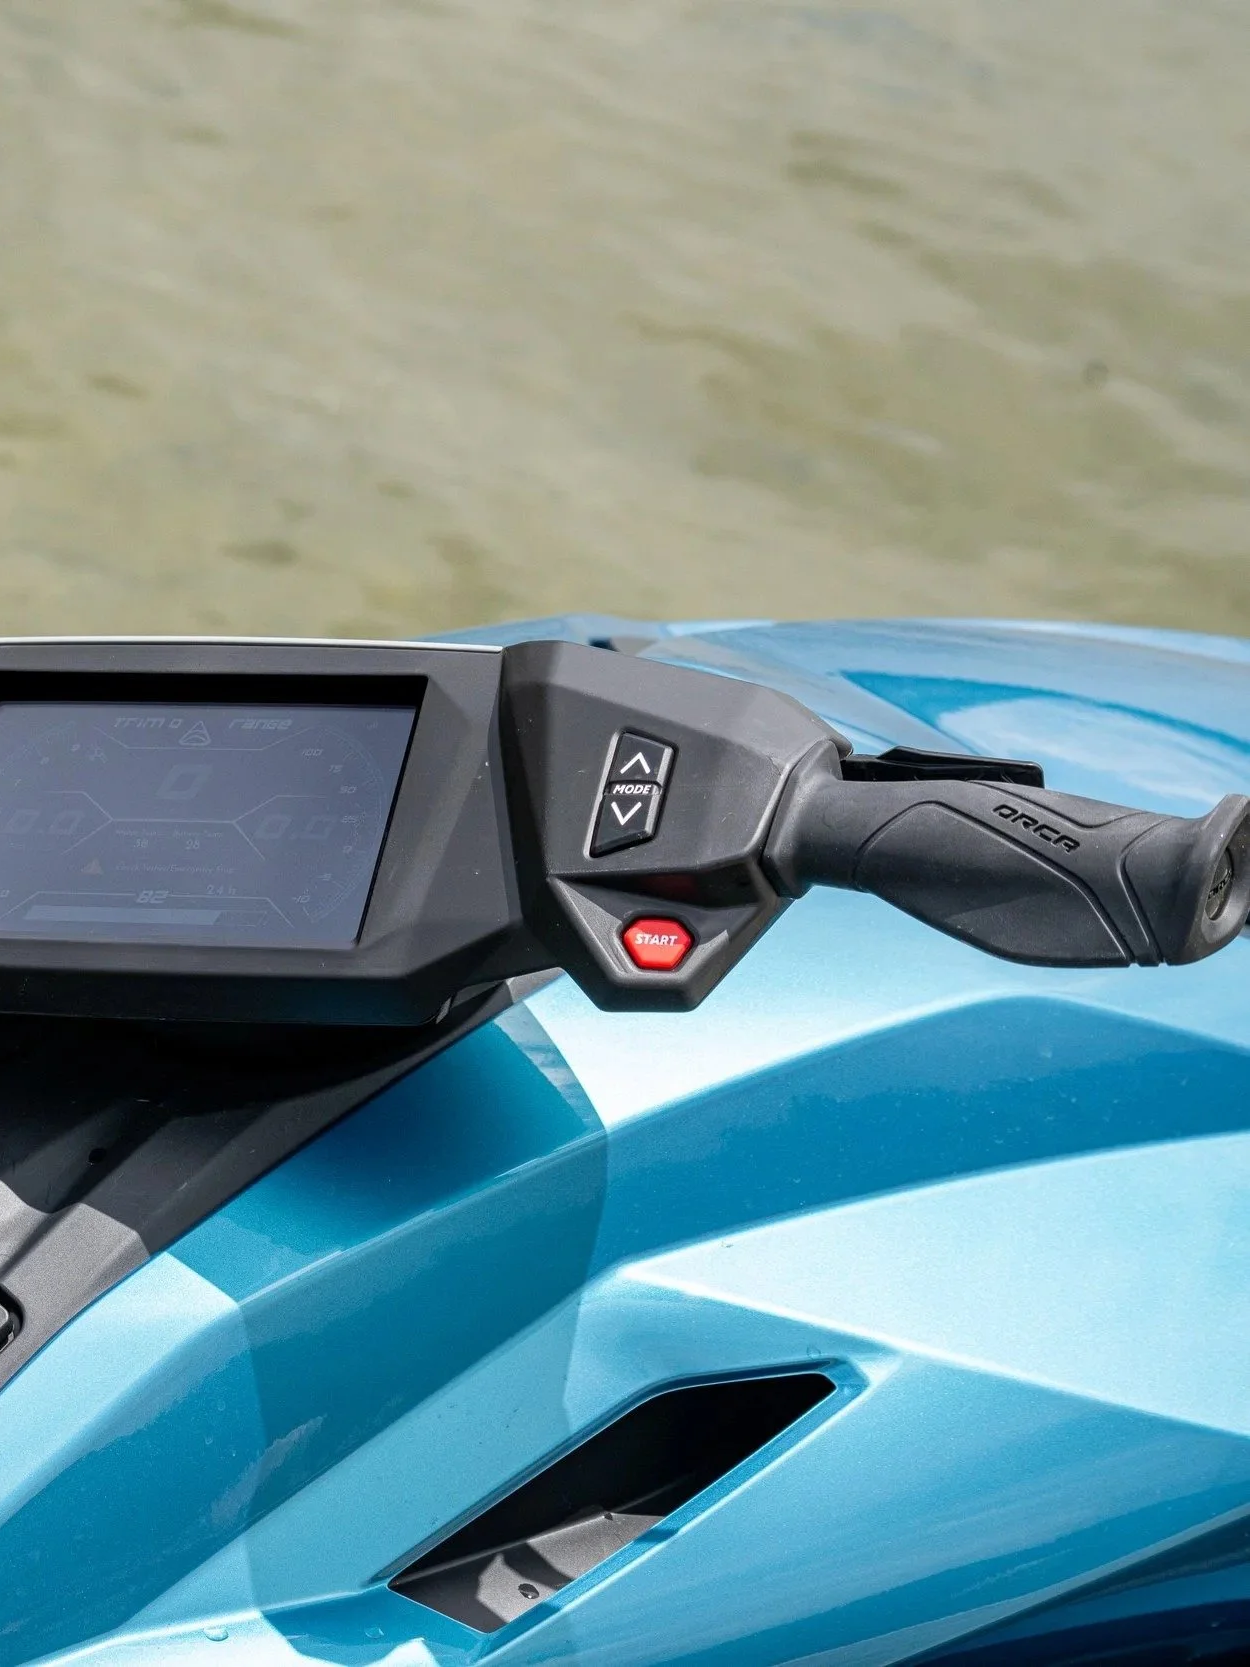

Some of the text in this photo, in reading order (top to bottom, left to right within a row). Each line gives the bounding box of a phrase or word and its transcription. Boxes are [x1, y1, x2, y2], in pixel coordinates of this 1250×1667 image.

[613, 783, 652, 795] MODE
[992, 803, 1081, 853] ORCA
[634, 933, 678, 946] START
